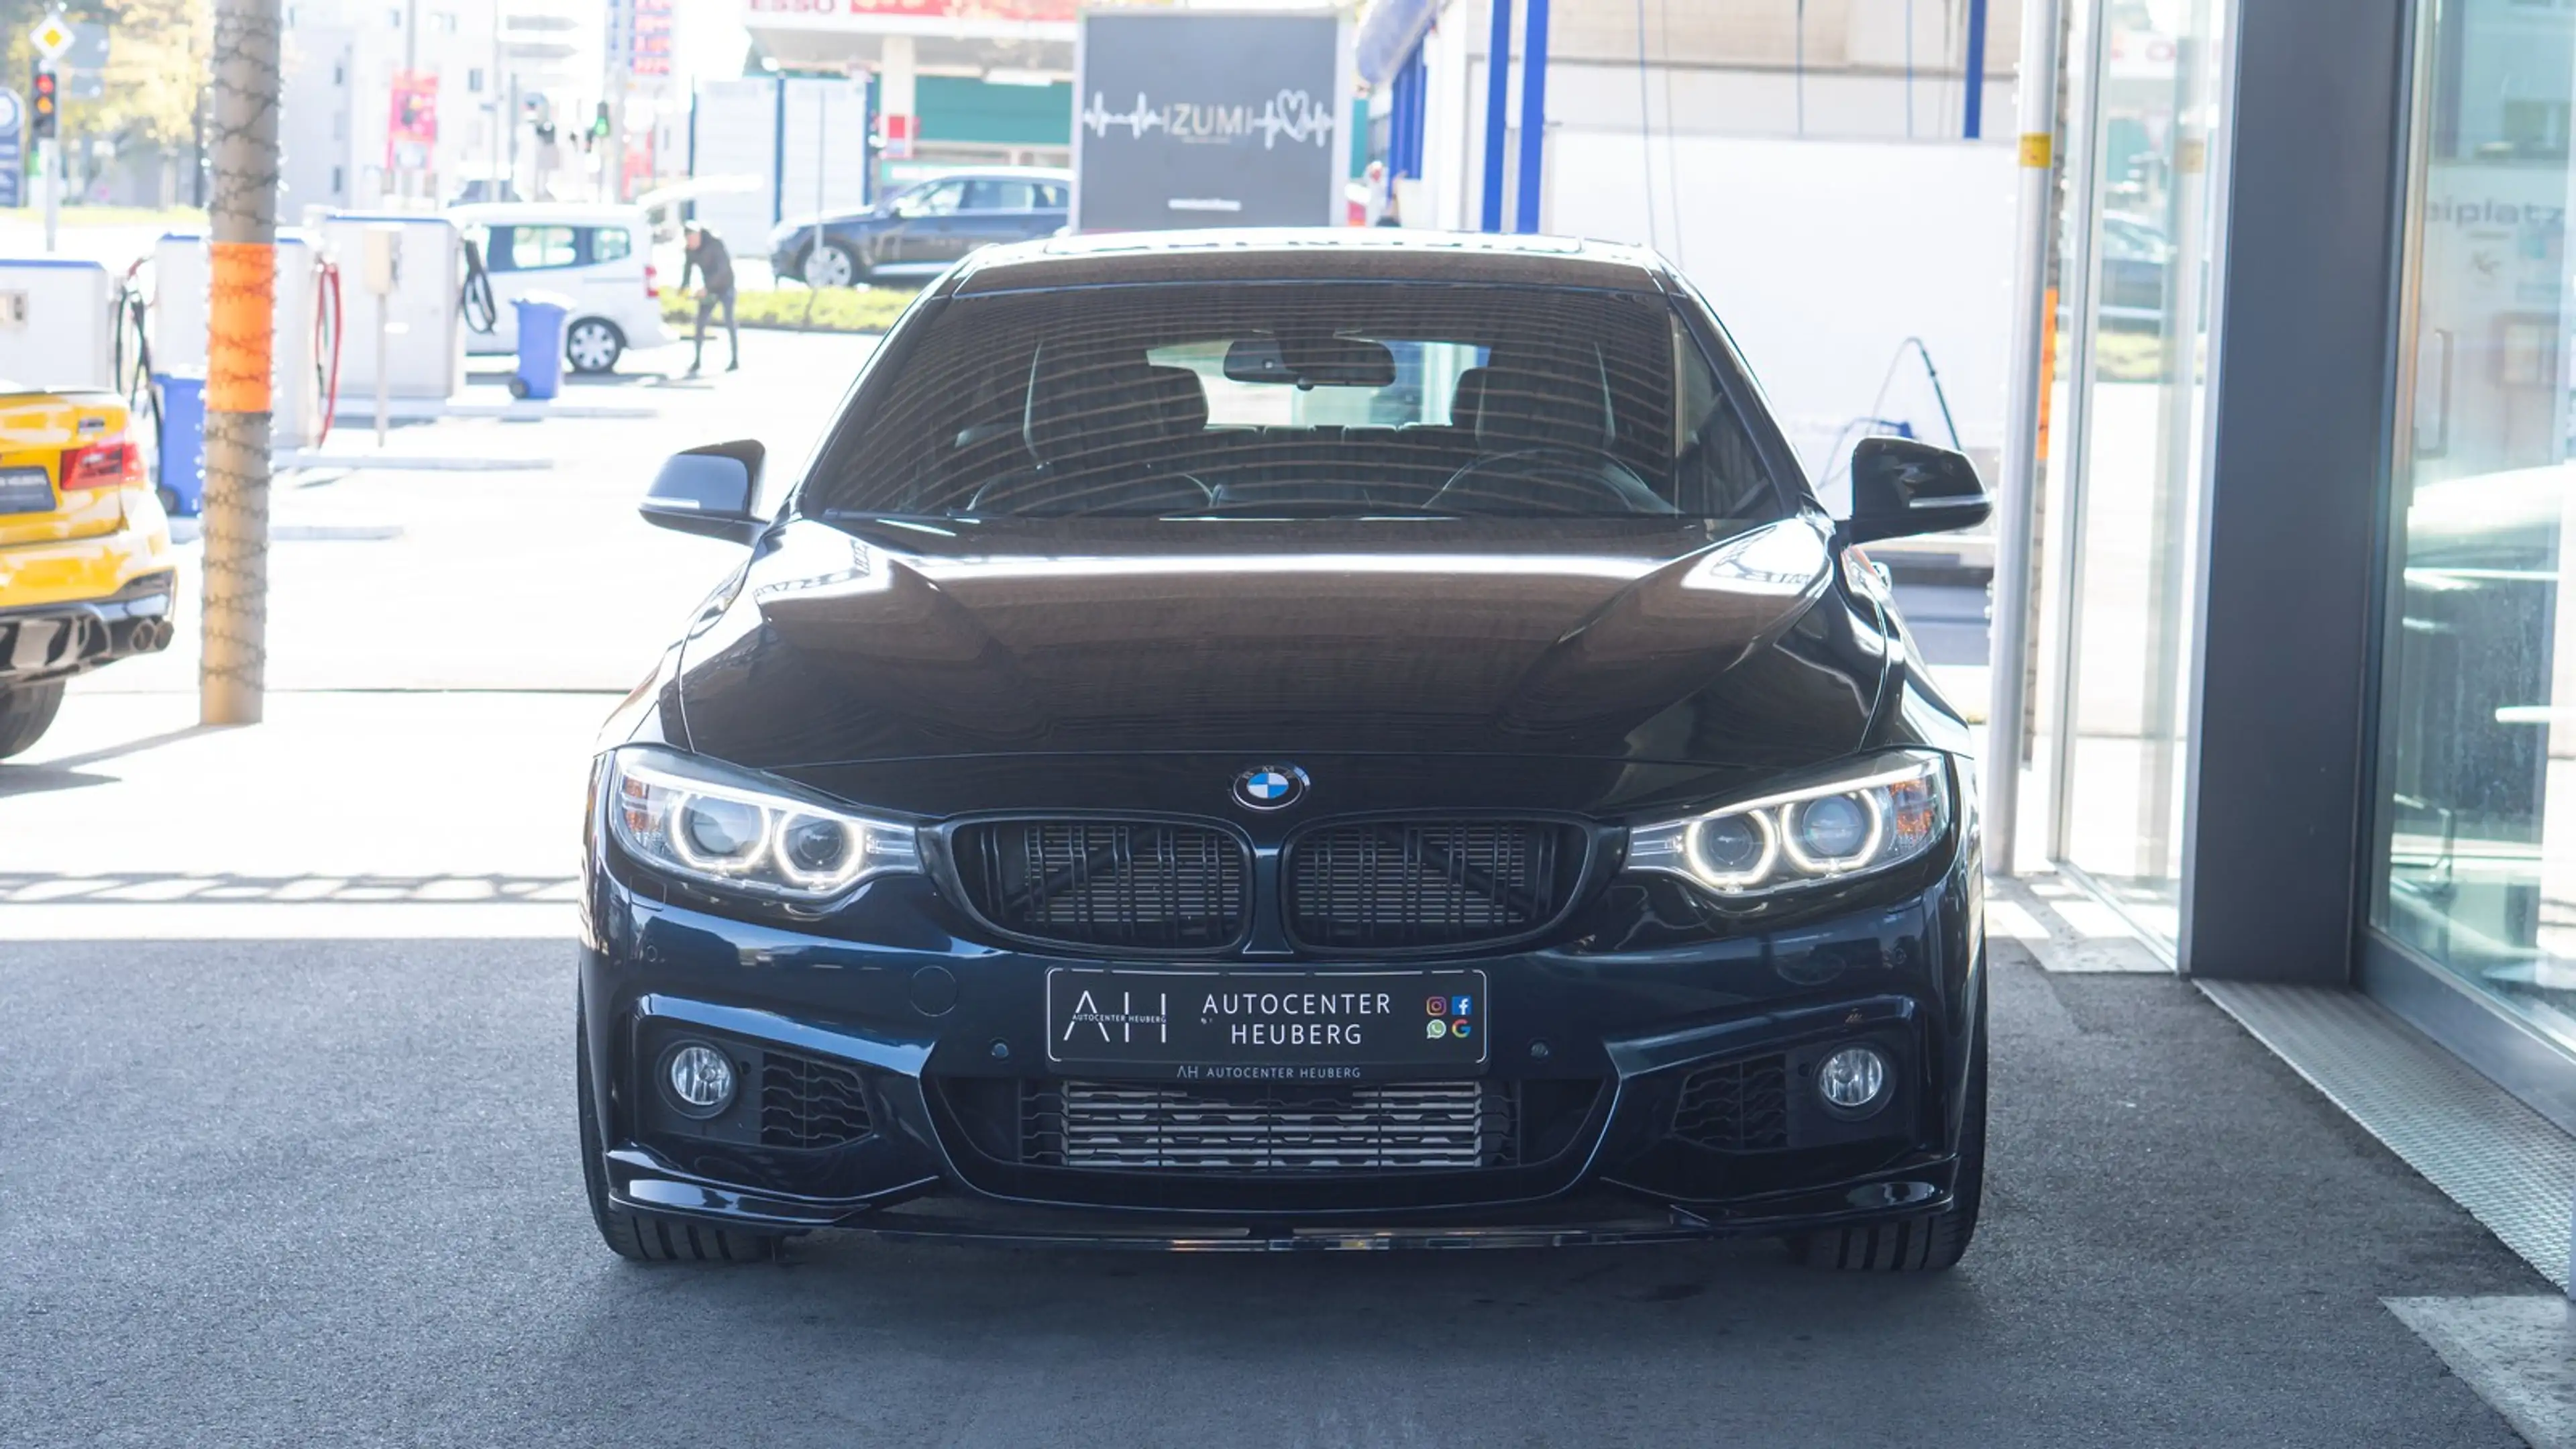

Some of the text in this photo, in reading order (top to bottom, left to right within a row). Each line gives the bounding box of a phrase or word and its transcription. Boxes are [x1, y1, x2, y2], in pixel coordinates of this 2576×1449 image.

[1162, 103, 1254, 136] IZUMI
[1202, 993, 1391, 1015] AUTOCENTER
[1072, 1014, 1167, 1024] AUTOCENTER HEUBERG
[1231, 1023, 1362, 1044] HEUBERG
[1208, 1067, 1294, 1079] AUTOCENTER
[1300, 1067, 1361, 1078] HEUBERG
